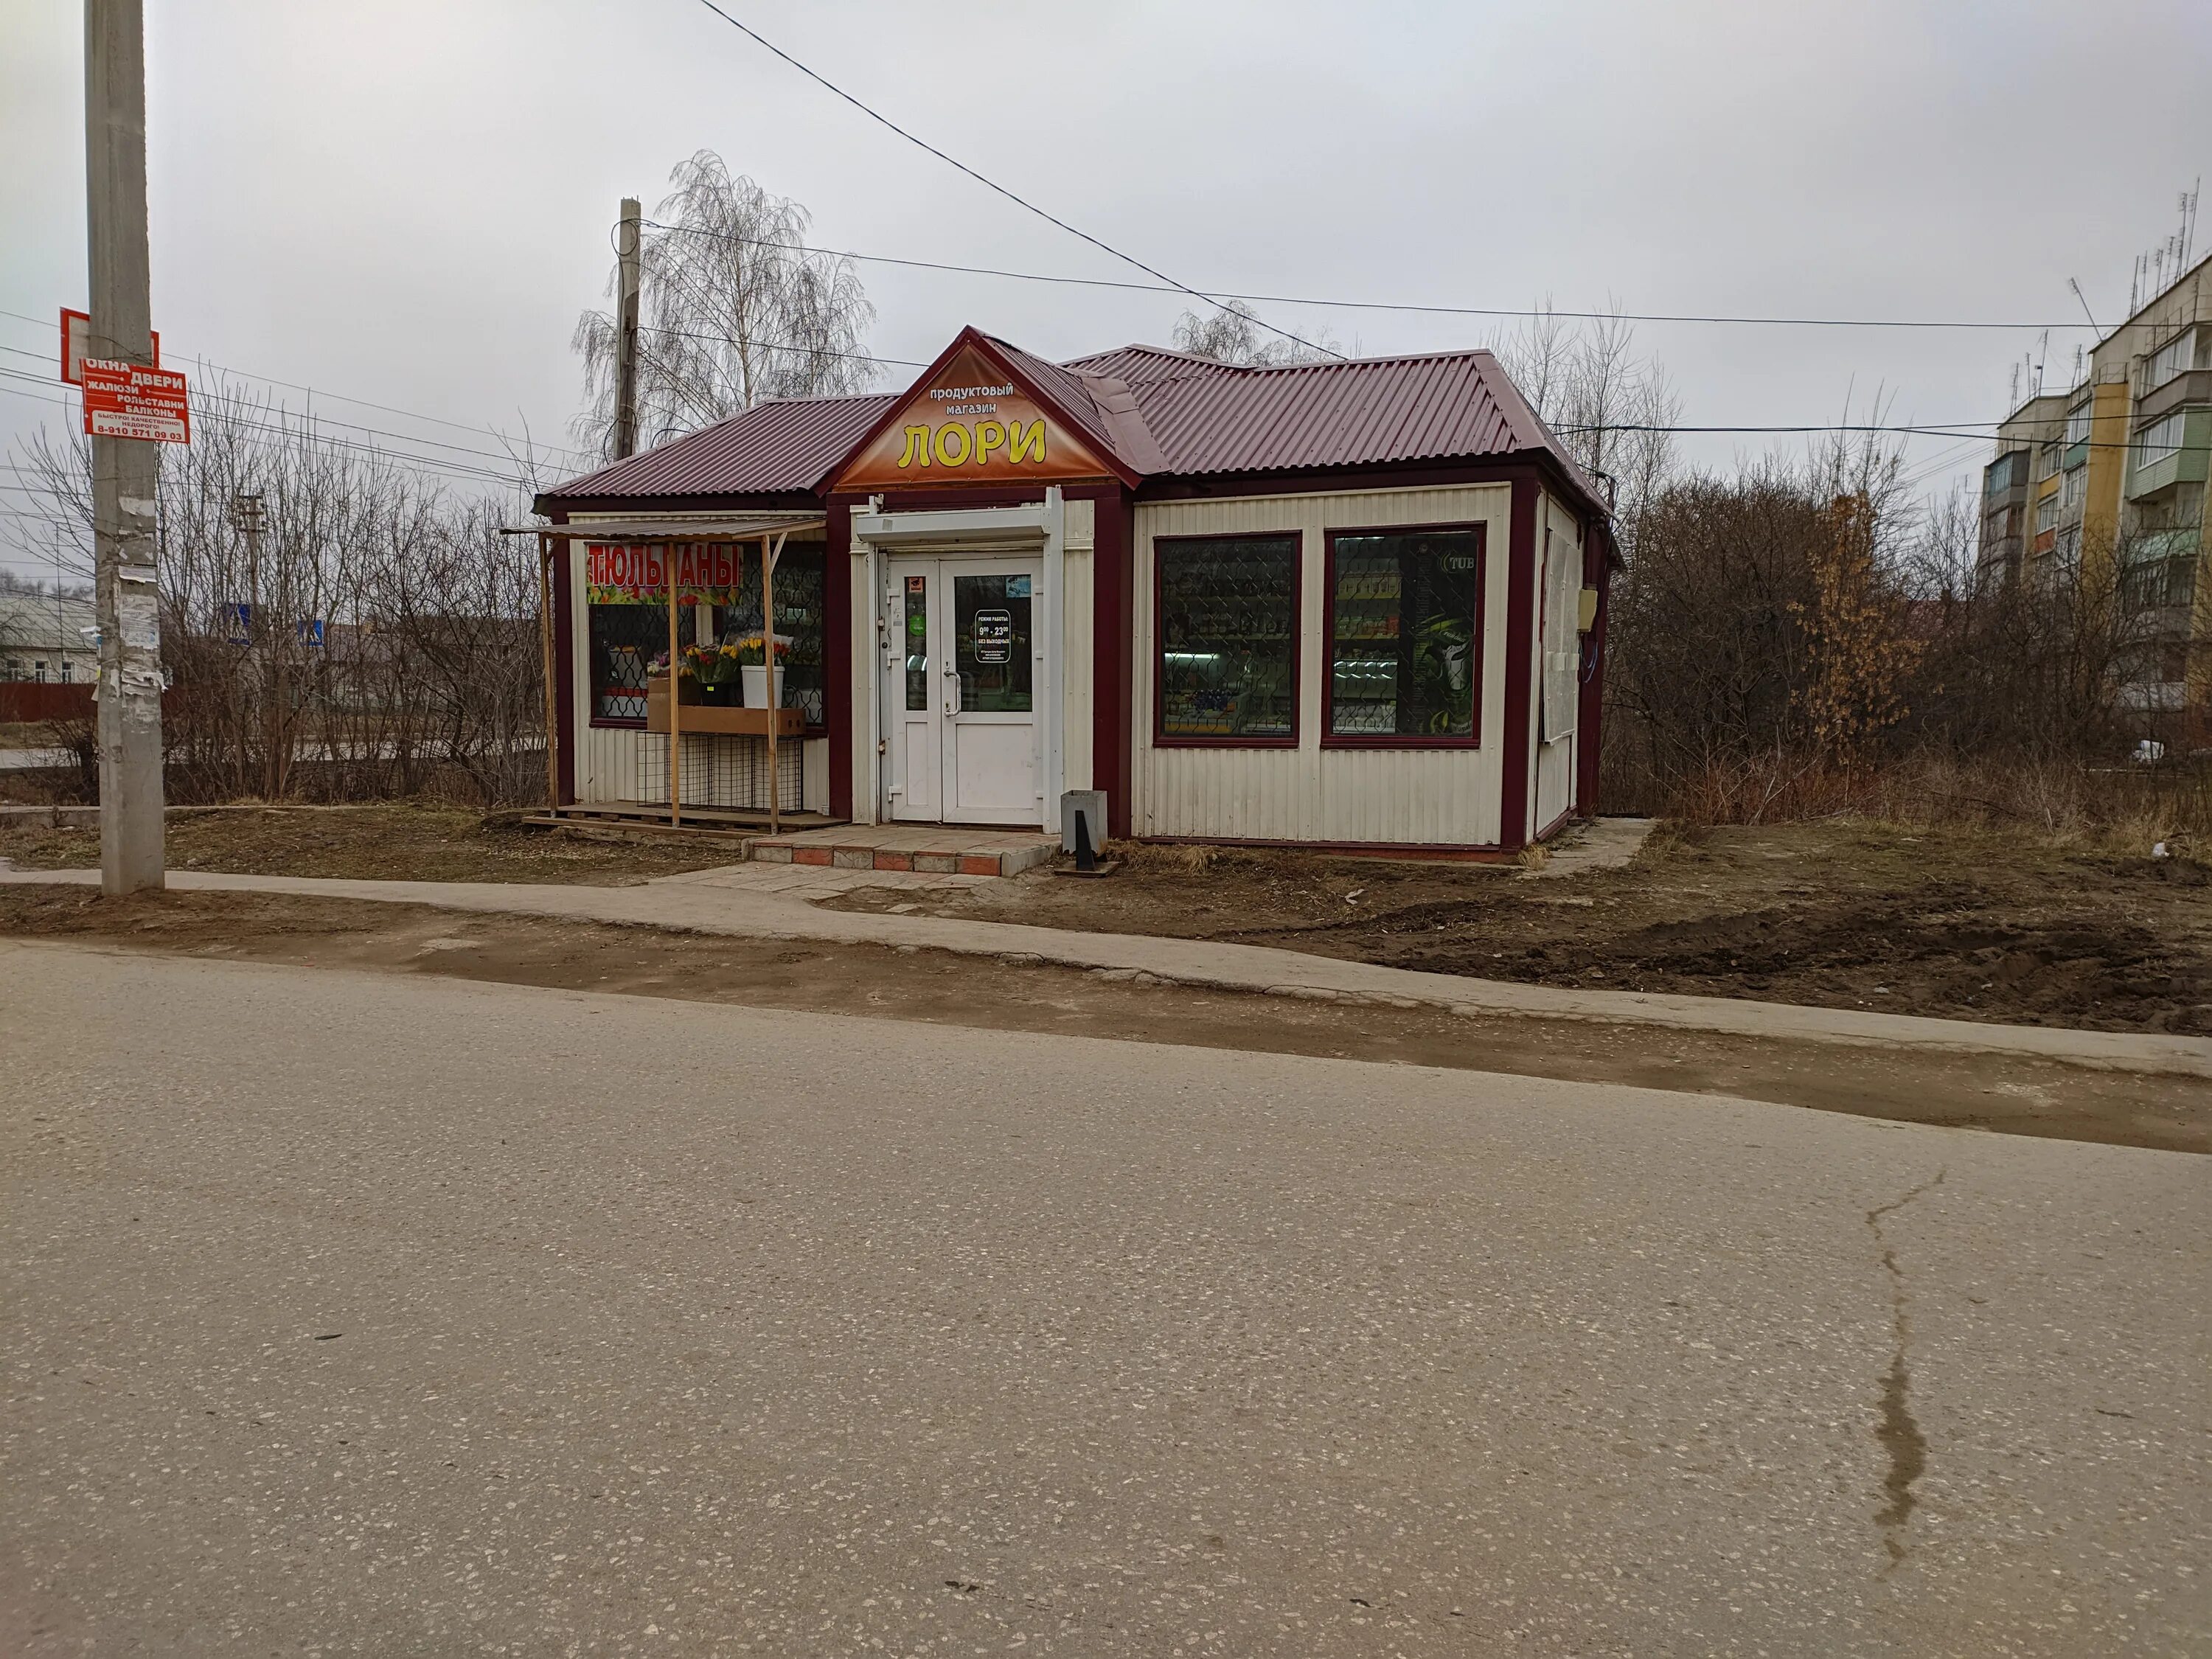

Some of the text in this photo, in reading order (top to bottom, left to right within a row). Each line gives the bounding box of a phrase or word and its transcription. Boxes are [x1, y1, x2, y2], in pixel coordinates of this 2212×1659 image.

[86, 358, 131, 372] ОКНА
[87, 380, 139, 394] ЖАЛЮЗИ
[131, 372, 183, 389] ДВЕРИ
[930, 383, 1014, 402] продуктовый
[117, 394, 184, 409] РОЛЬСТАВНИ
[125, 405, 177, 418] БАЛКОНЫ
[946, 403, 996, 416] магазин
[98, 413, 180, 426] БЫСТРО! КАЧЕСТВЕННО!
[122, 421, 160, 429] НЕДОРОГО!
[98, 425, 182, 440] 8-910 571 09 03
[897, 419, 1046, 468] ЛОРИ
